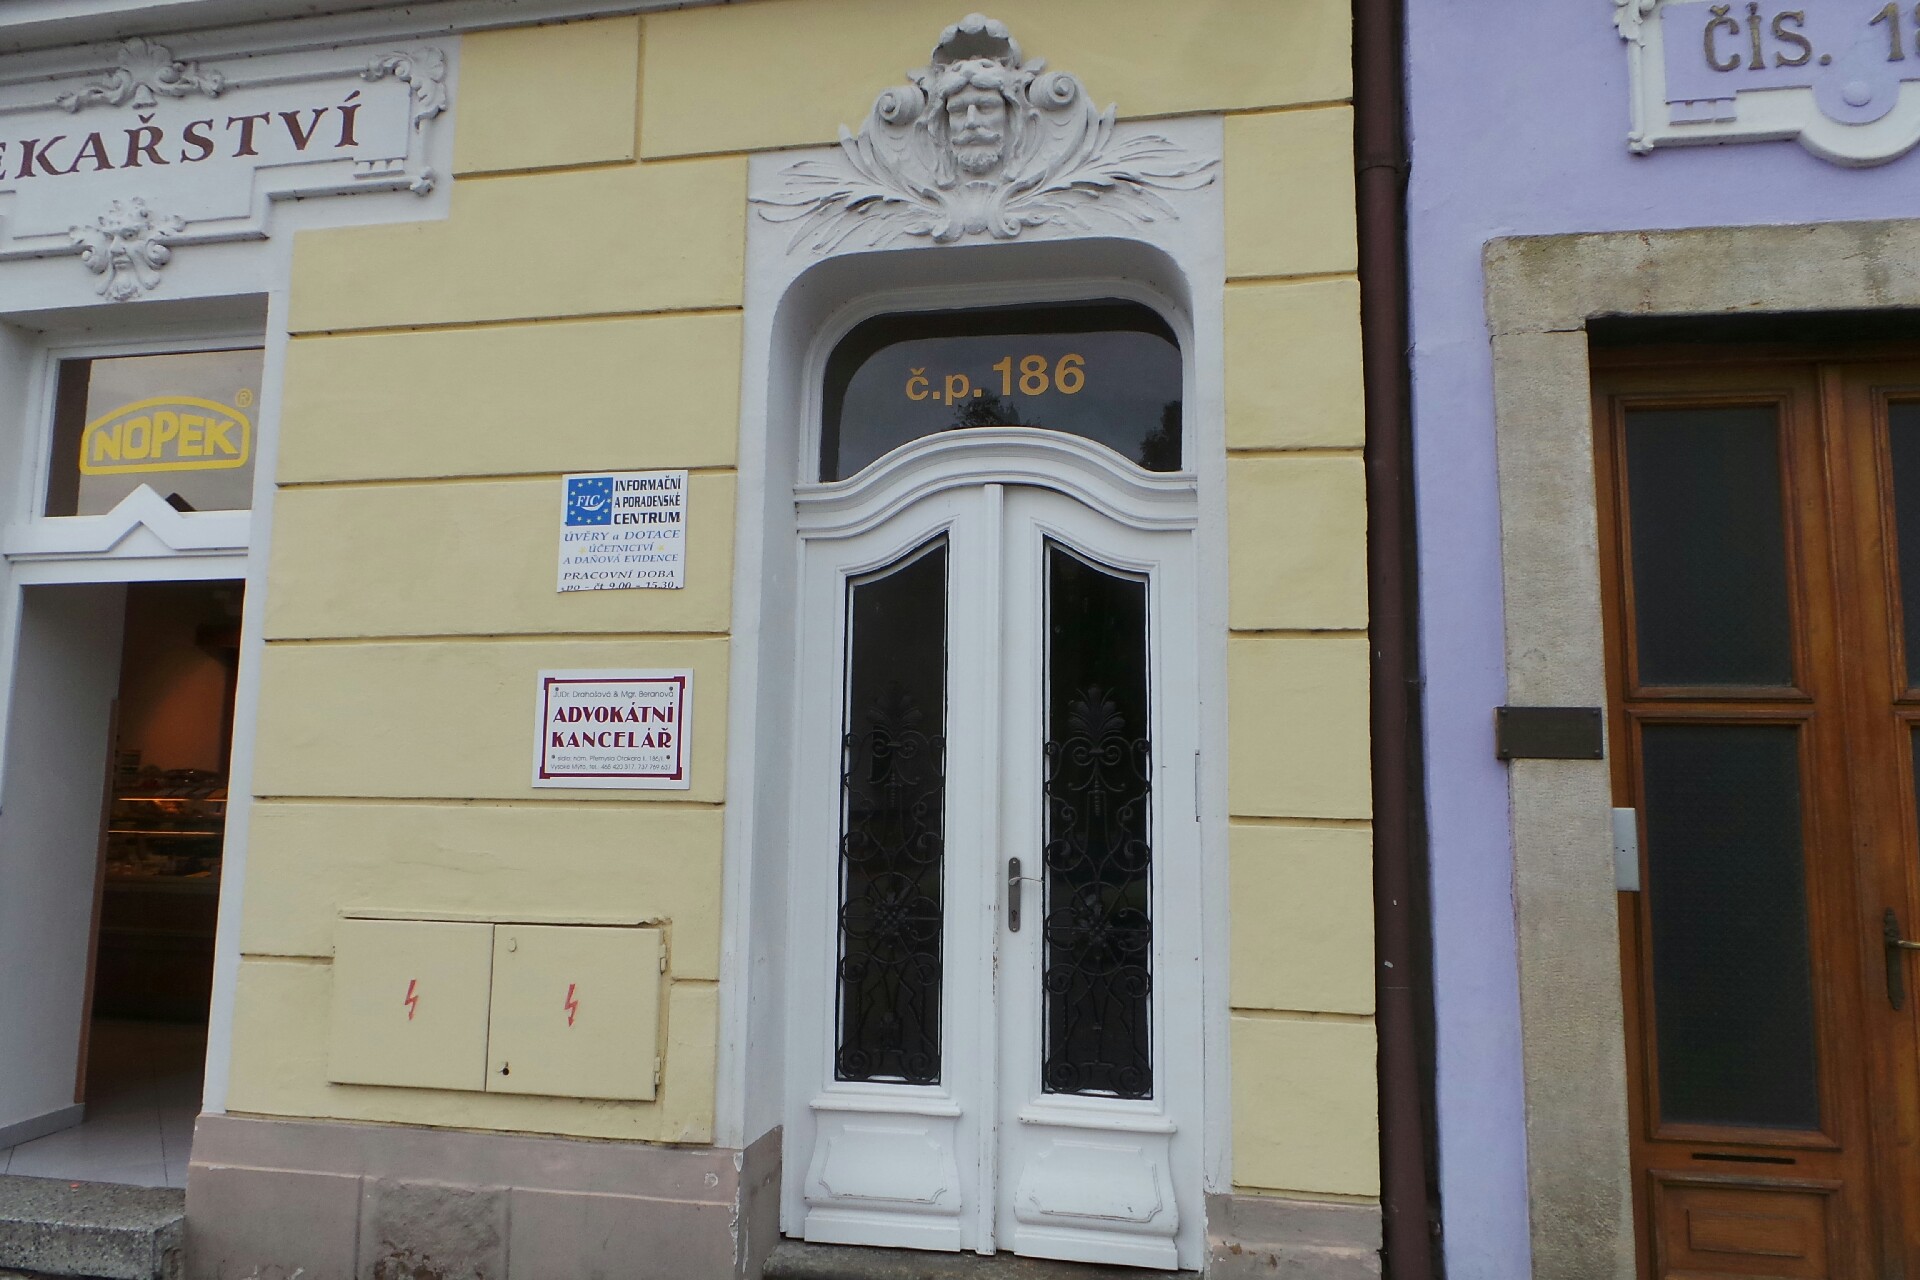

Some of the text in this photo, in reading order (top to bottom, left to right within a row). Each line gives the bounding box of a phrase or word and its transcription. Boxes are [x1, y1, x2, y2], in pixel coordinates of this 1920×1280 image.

[1868, 1, 1920, 63] 1
[905, 353, 1086, 406] č.p. 186
[93, 411, 239, 462] NOPEK
[615, 475, 682, 492] INFORMAČNÍ
[576, 494, 601, 508] FIC
[614, 492, 681, 509] A PORADENSKÉ
[613, 511, 681, 525] CENTRUM
[564, 529, 681, 542] ÚVĚRY a DOTACE
[588, 542, 655, 554] ÚČETNICTVÍ
[562, 553, 679, 565] A DAŇOVÁ EVIDENCE
[563, 569, 675, 581] PRACOVNÍ DOBA
[572, 689, 612, 699] Drahošová
[613, 690, 619, 699] &
[621, 690, 636, 700] Mgr.
[552, 701, 674, 723] ADVOKÁTNÍ
[551, 727, 672, 748] KANCELÁŘ
